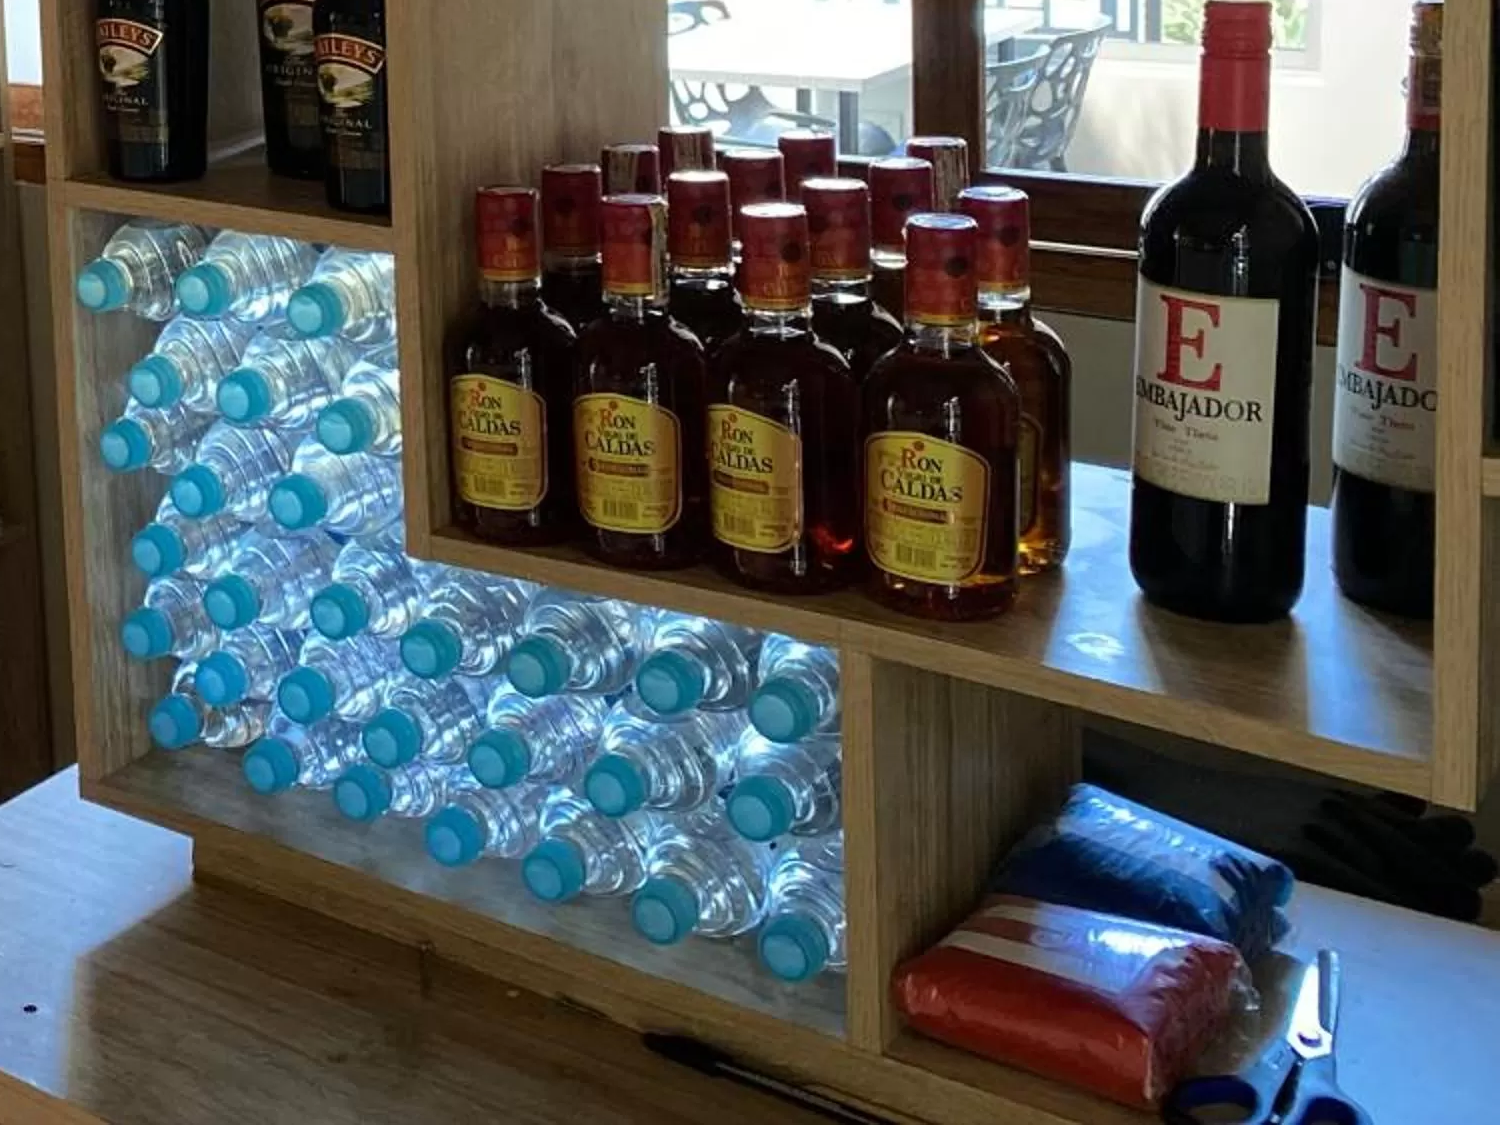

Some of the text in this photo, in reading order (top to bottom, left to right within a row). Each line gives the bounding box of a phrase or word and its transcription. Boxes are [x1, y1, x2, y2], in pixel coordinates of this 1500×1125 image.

[99, 23, 153, 47] AILEYS
[315, 39, 380, 65] AILEYS
[1159, 293, 1223, 392] E
[1359, 282, 1418, 382] E
[467, 387, 503, 410] RON
[1135, 377, 1263, 423] EMBAJADOR
[458, 410, 522, 436] CALDAS
[600, 408, 636, 429] RON
[721, 418, 754, 444] RON
[584, 430, 655, 456] CALDAS
[711, 440, 773, 473] CALDAS
[899, 447, 945, 473] RON
[880, 467, 965, 504] CALDAS
